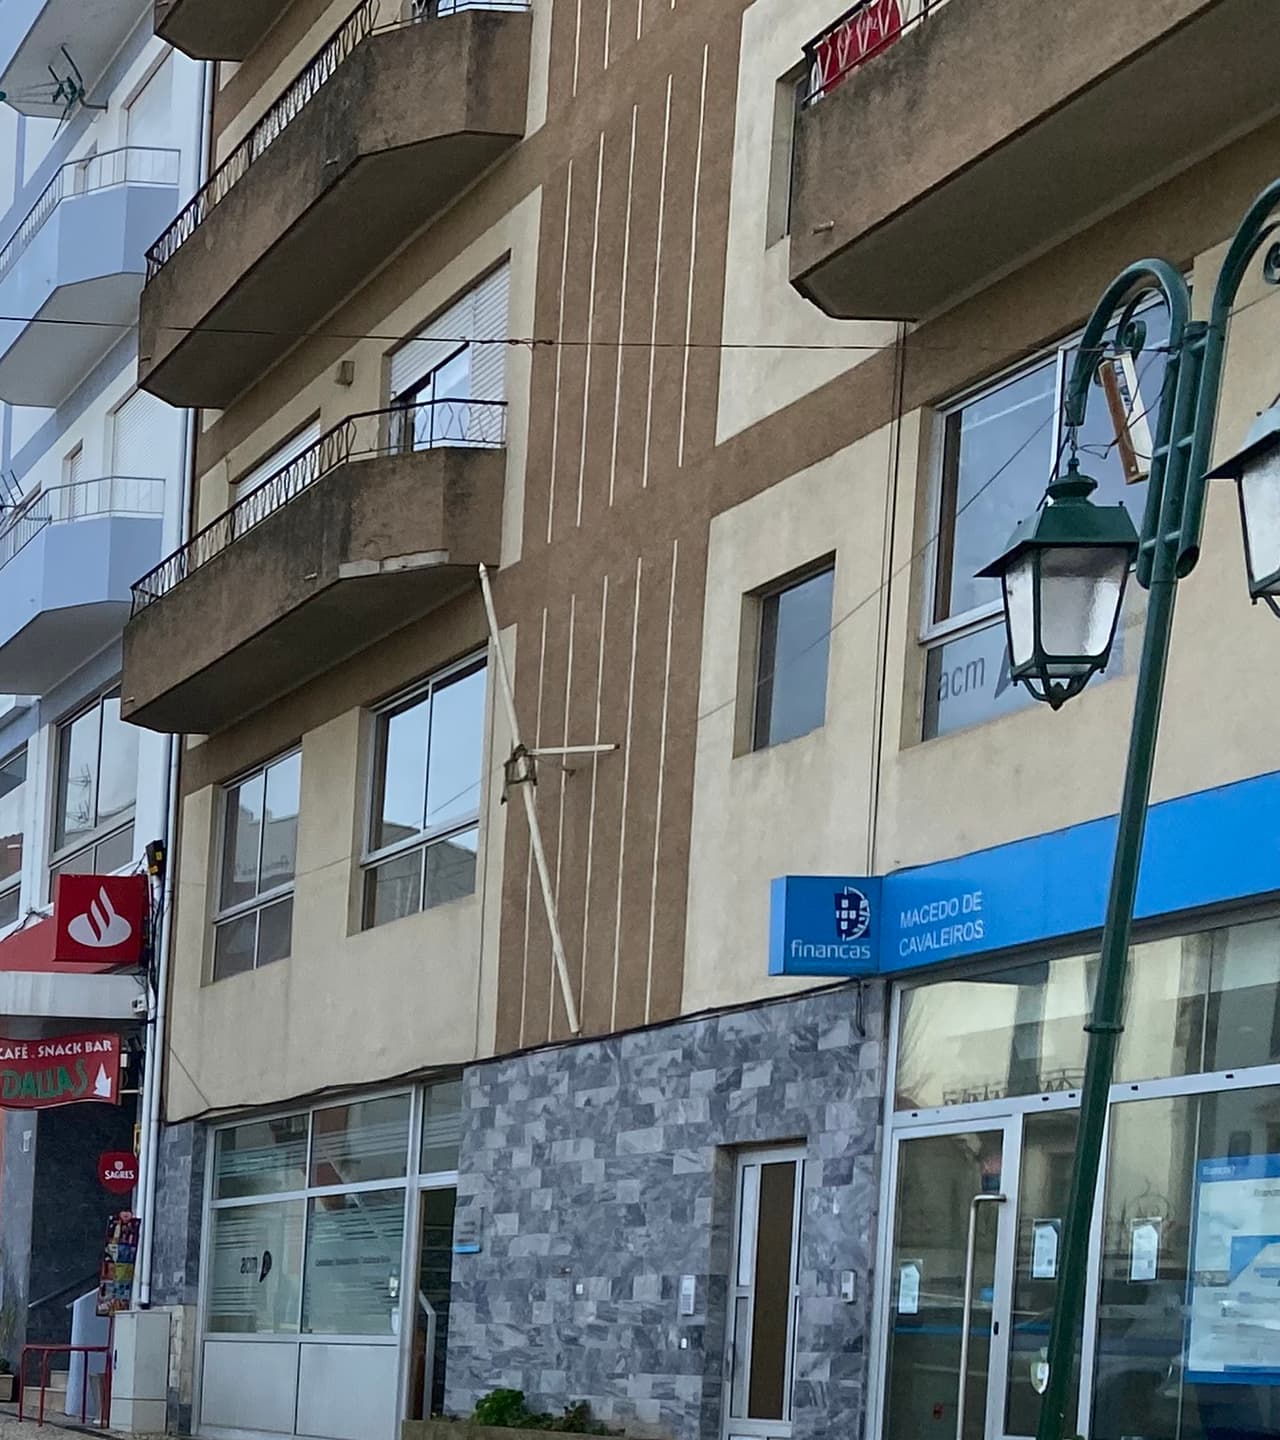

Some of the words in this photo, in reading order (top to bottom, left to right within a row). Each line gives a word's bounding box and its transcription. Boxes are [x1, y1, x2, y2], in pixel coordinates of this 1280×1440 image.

[938, 657, 984, 701] acm
[900, 898, 959, 929] MACEDO
[961, 891, 983, 914] DE
[899, 919, 985, 956] CAVALEIROS
[37, 1042, 82, 1058] SNACK
[85, 1039, 113, 1053] BAR
[0, 1059, 88, 1099] DALLAS
[104, 1169, 134, 1180] SAGRES
